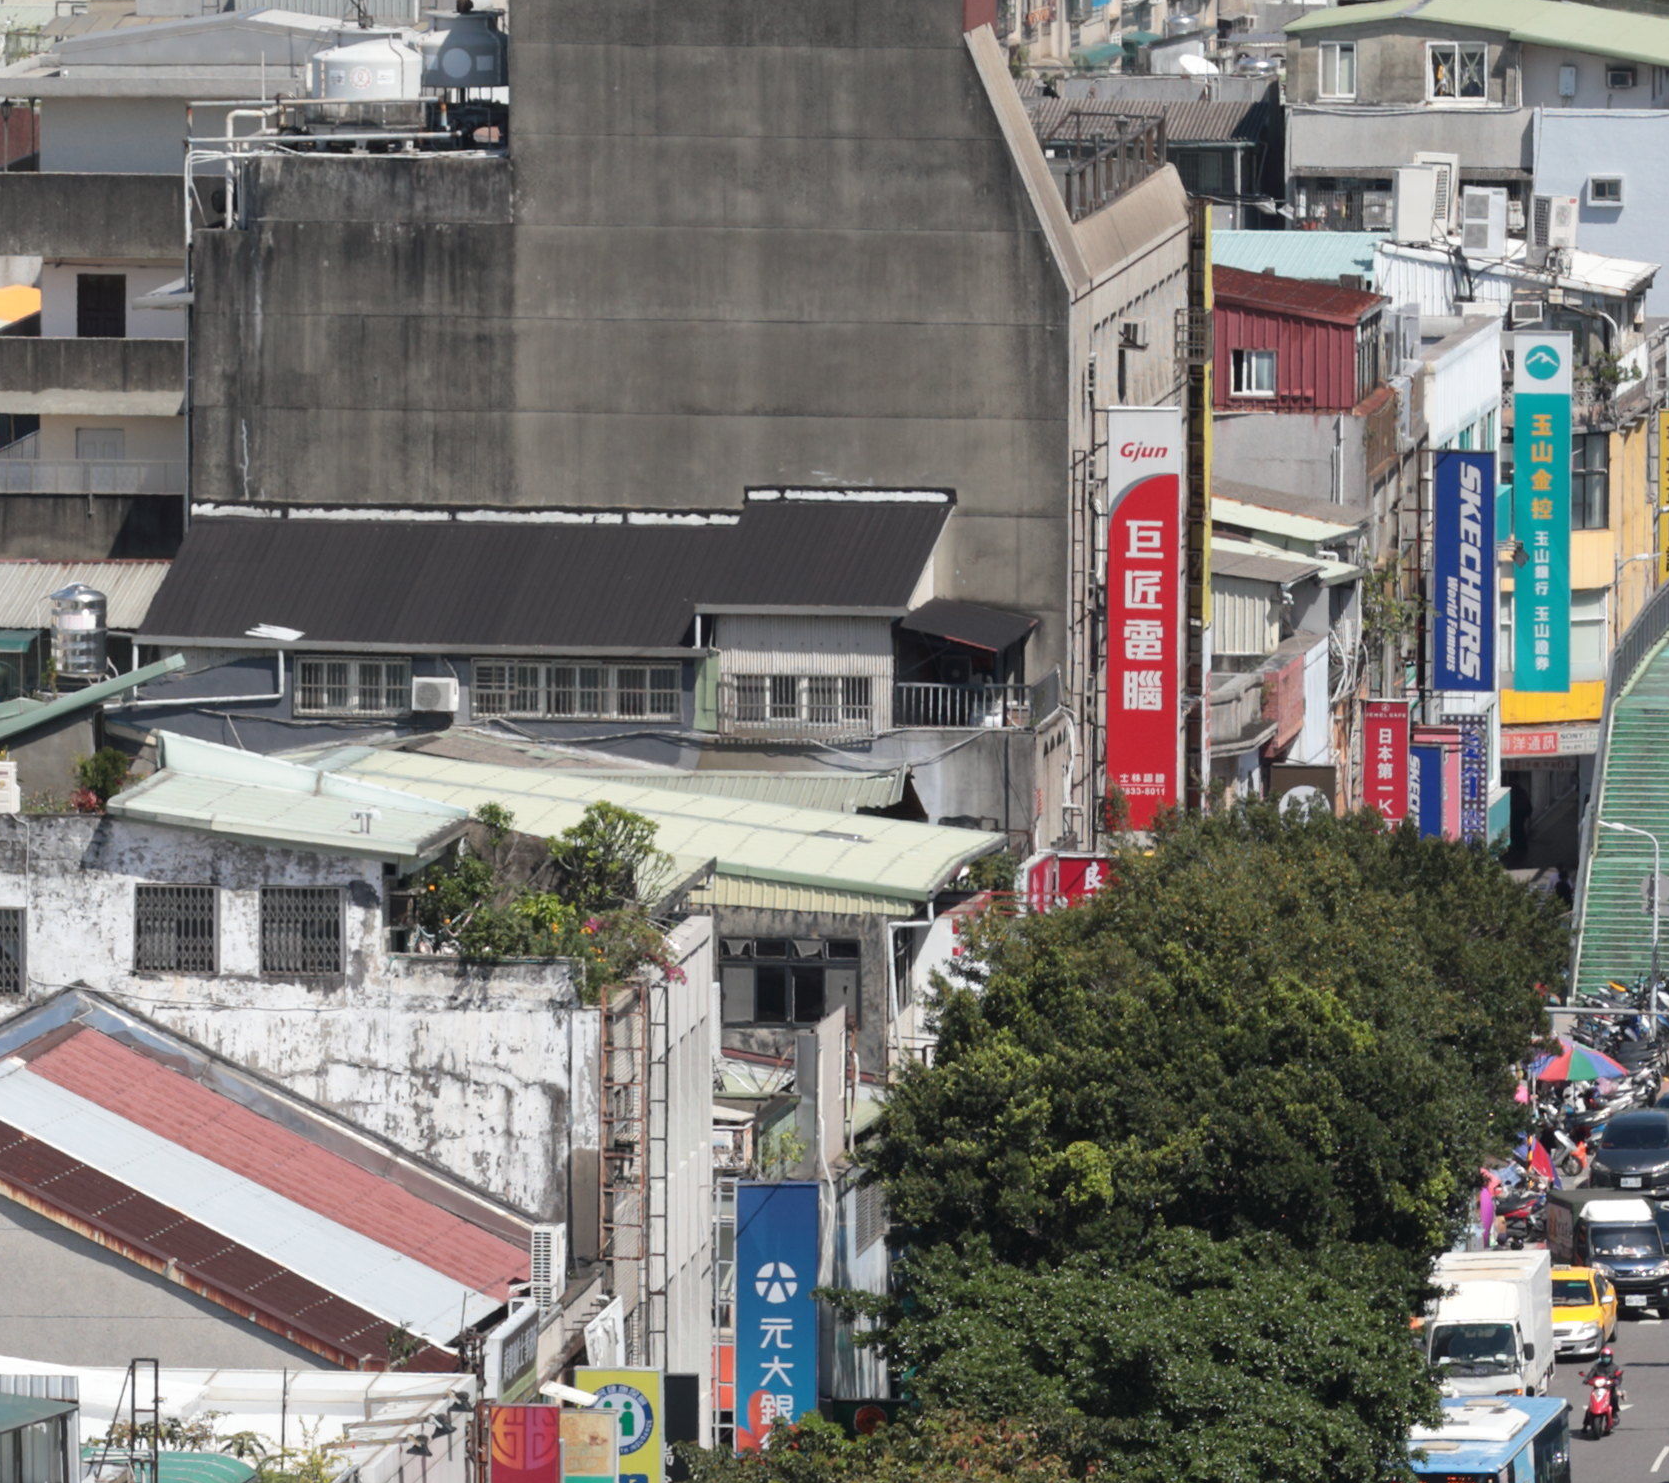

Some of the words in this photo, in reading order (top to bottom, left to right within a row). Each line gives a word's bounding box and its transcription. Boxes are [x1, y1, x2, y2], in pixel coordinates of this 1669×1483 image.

[1120, 441, 1169, 462] Gjun
[1531, 413, 1553, 521] 玉山金控
[1460, 461, 1482, 682] SKECHERS
[1535, 531, 1550, 596] 玉山銀行
[1123, 519, 1164, 712] 巨匠電腦
[1447, 575, 1458, 618] World
[1446, 618, 1458, 672] Famous
